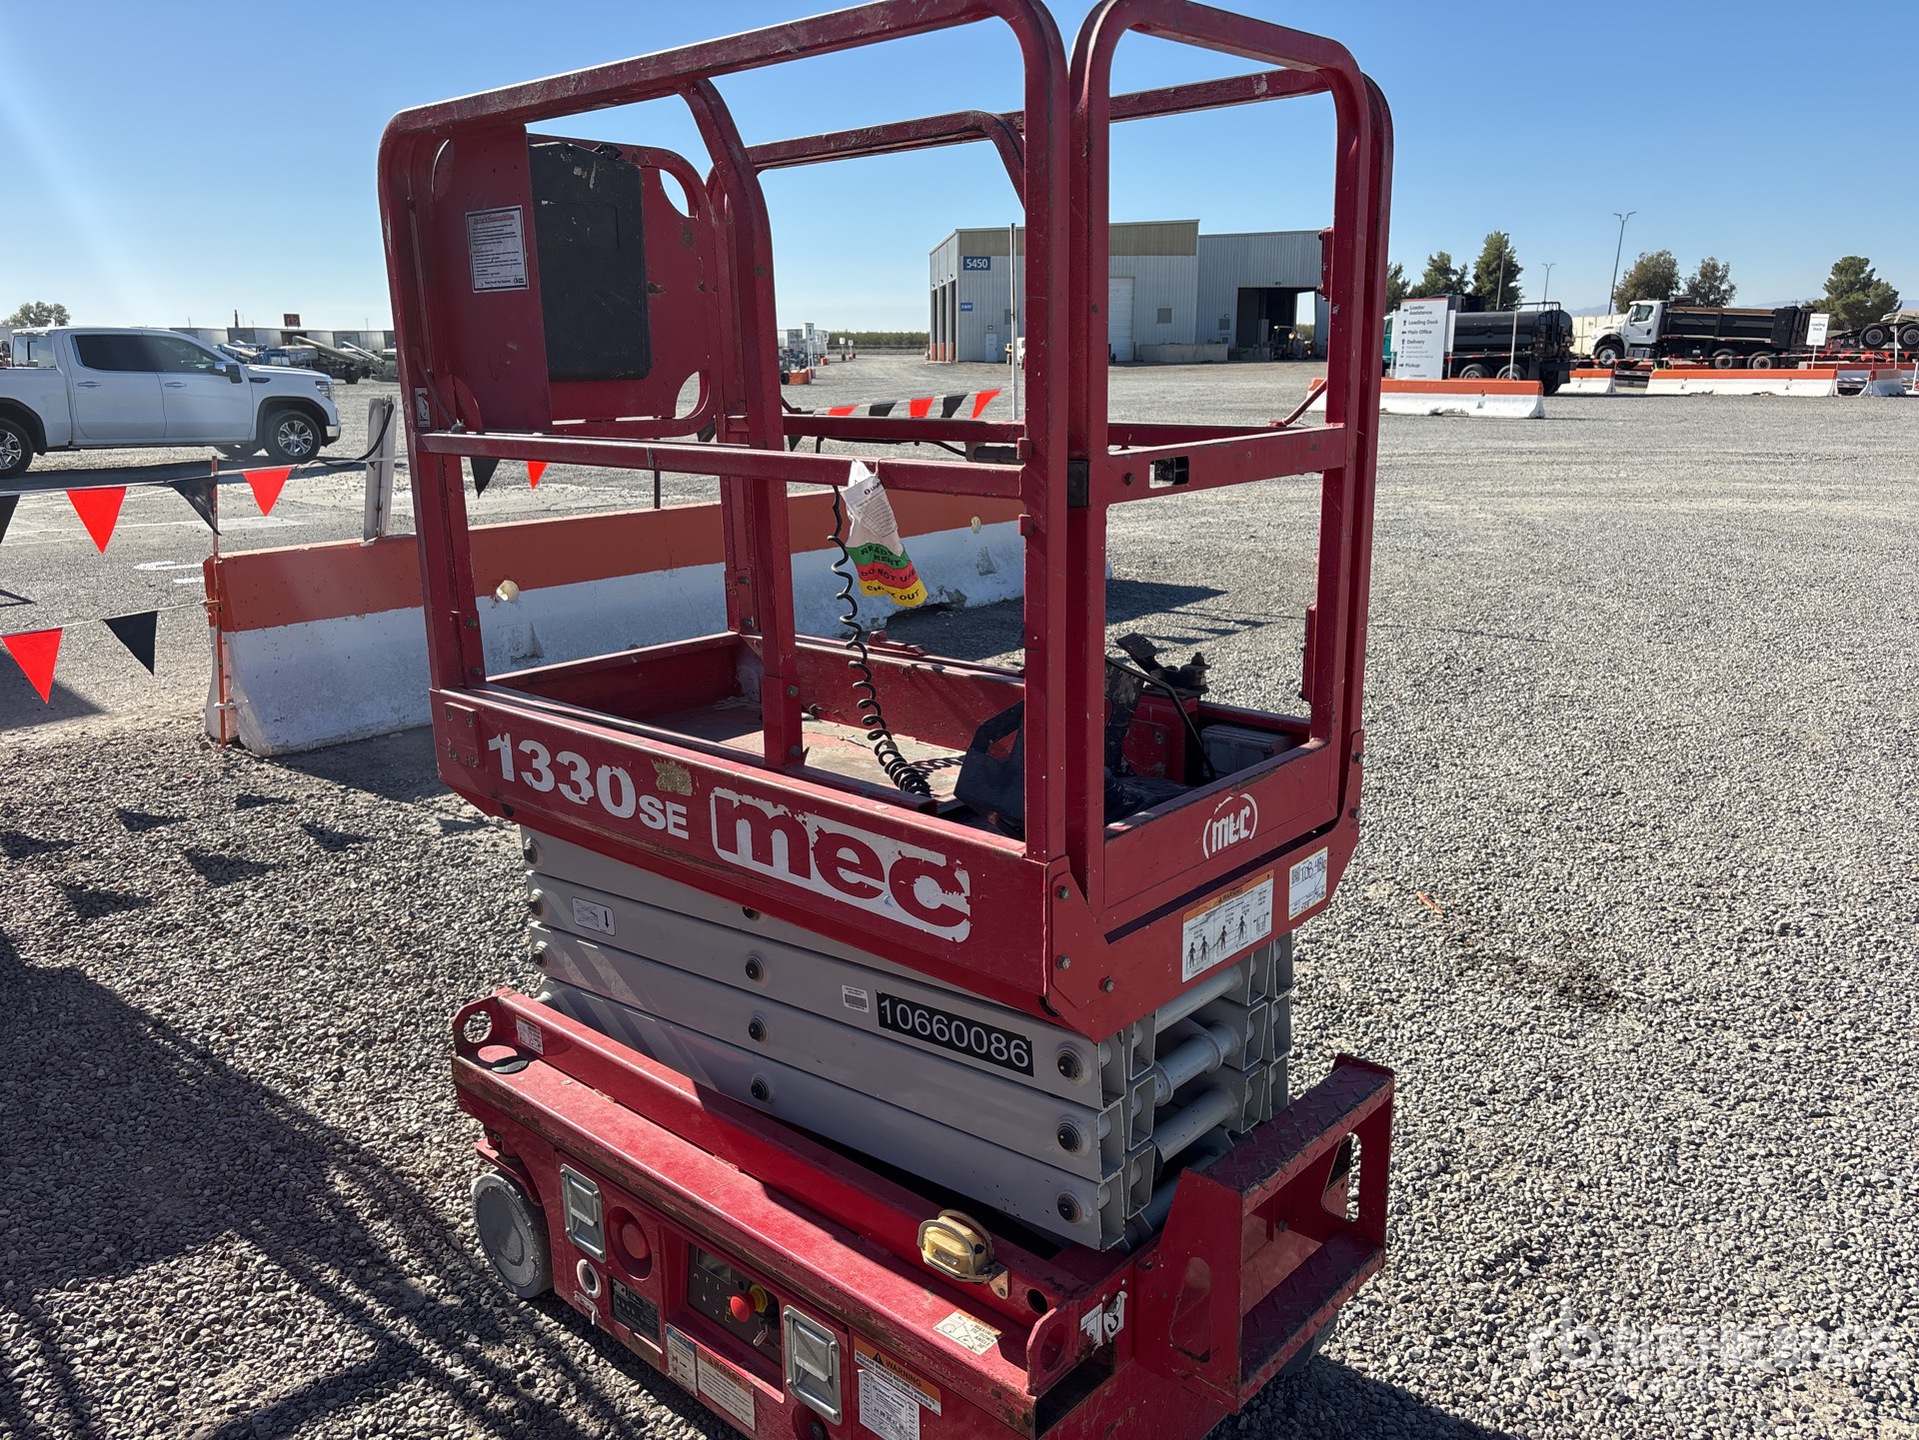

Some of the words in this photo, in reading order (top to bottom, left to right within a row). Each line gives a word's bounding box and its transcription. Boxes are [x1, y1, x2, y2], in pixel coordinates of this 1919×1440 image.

[966, 258, 988, 269] 5450
[873, 554, 902, 566] RENT
[860, 568, 875, 577] DO
[877, 569, 897, 581] NOT
[899, 589, 920, 601] OUT
[879, 997, 1030, 1069] 10660086
[713, 1357, 743, 1386] WARNING
[885, 1359, 922, 1387] WARNING
